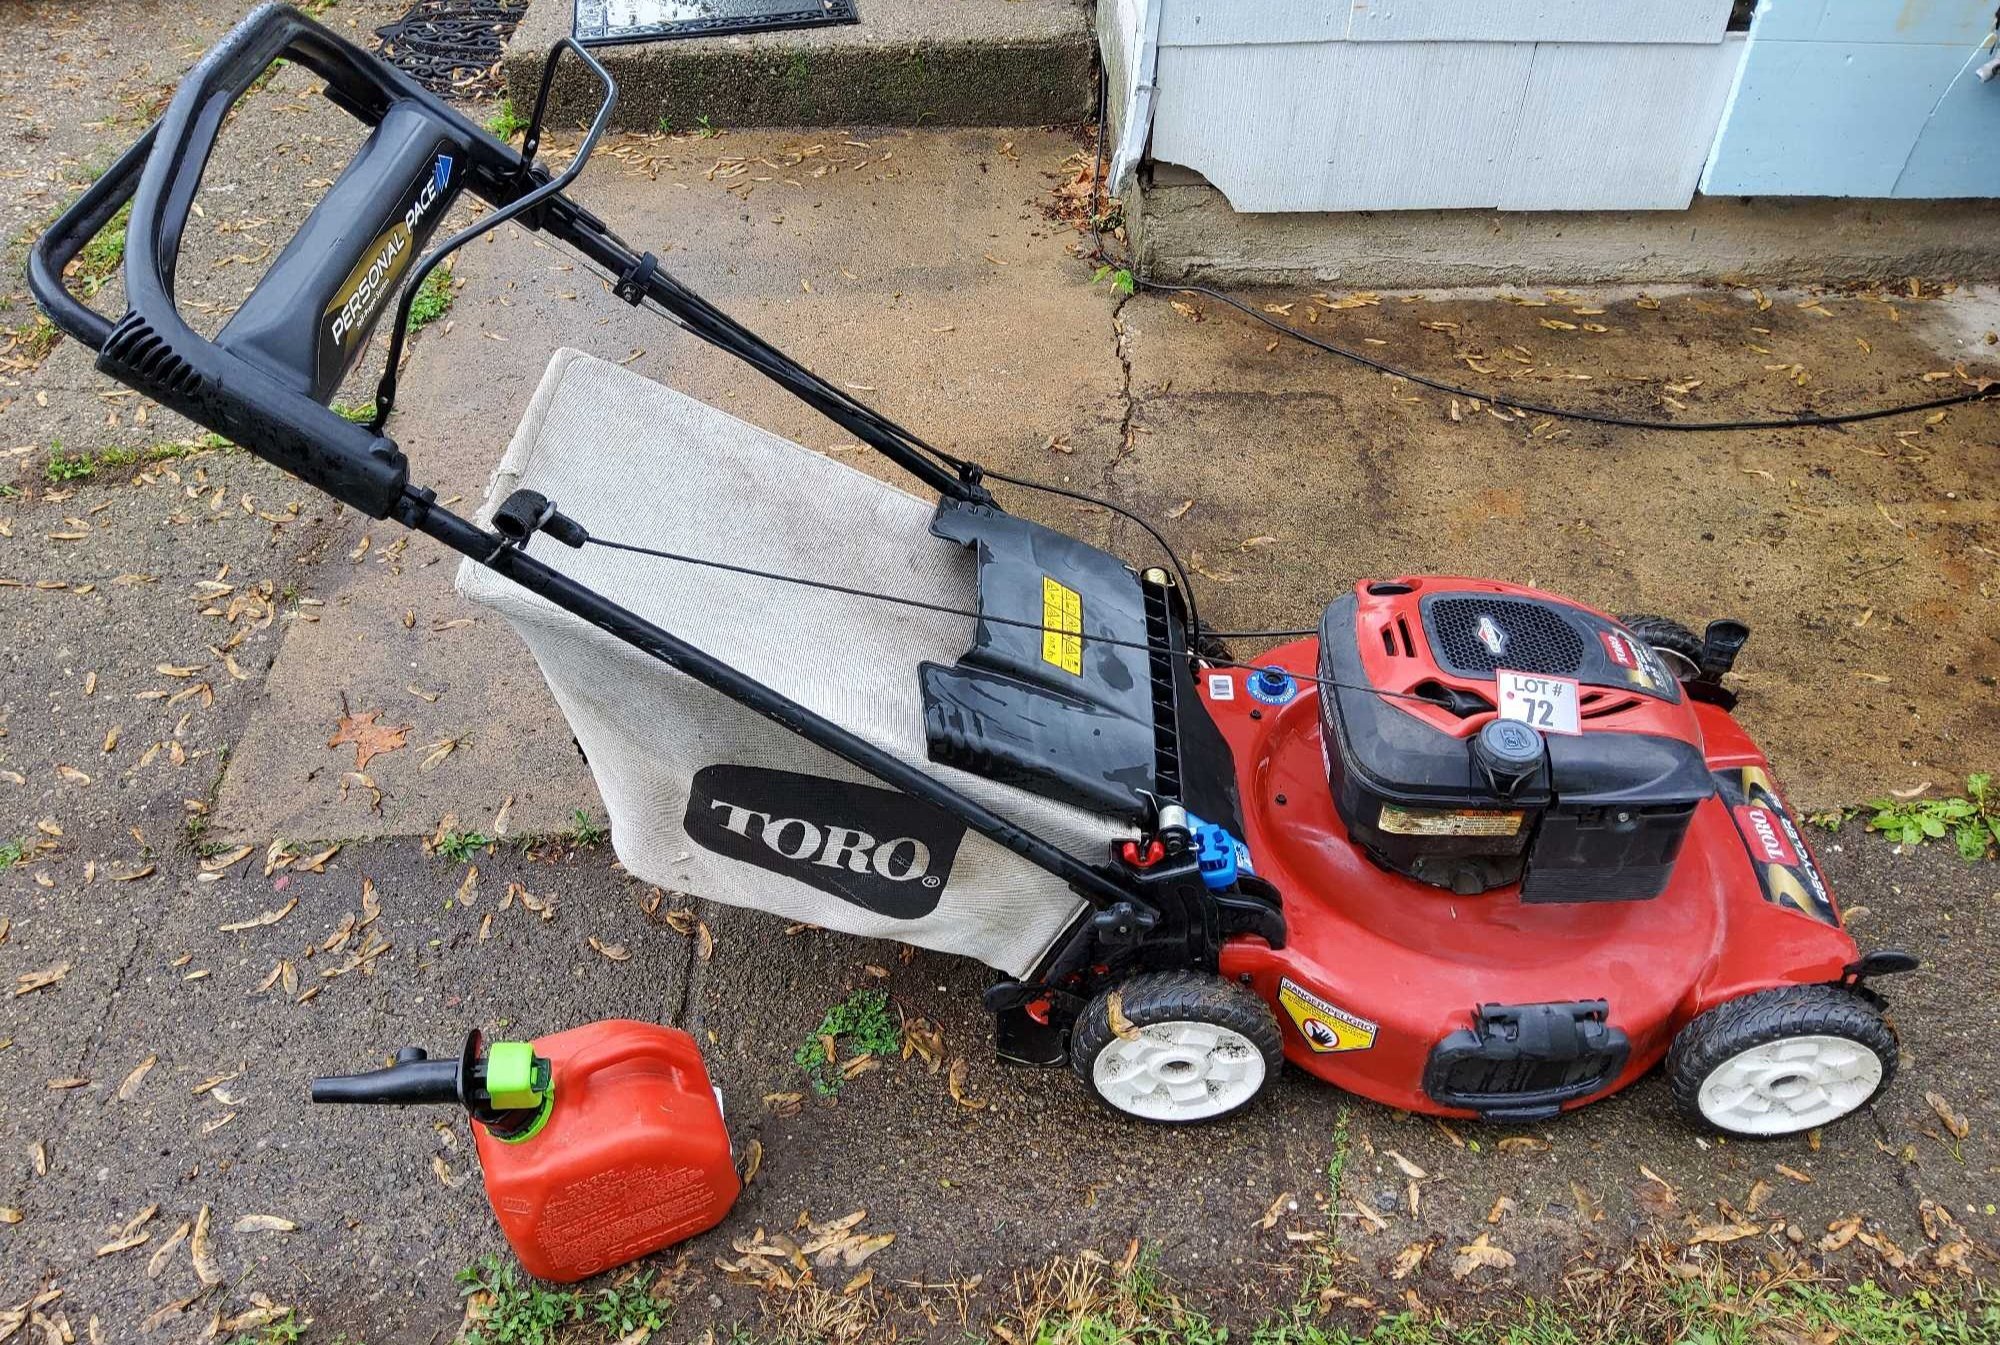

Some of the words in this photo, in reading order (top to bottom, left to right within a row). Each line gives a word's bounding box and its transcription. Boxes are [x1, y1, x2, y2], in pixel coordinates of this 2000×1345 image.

[331, 232, 405, 346] PERSONAL
[405, 175, 437, 235] PACE
[1513, 676, 1549, 695] LOT
[1552, 683, 1563, 697] #
[1522, 698, 1554, 727] 72
[710, 799, 931, 881] TORO
[1750, 809, 1785, 860] TORO
[1781, 816, 1829, 903] RECYCLER
[1284, 980, 1375, 1033] DANGER/PELIGRO
